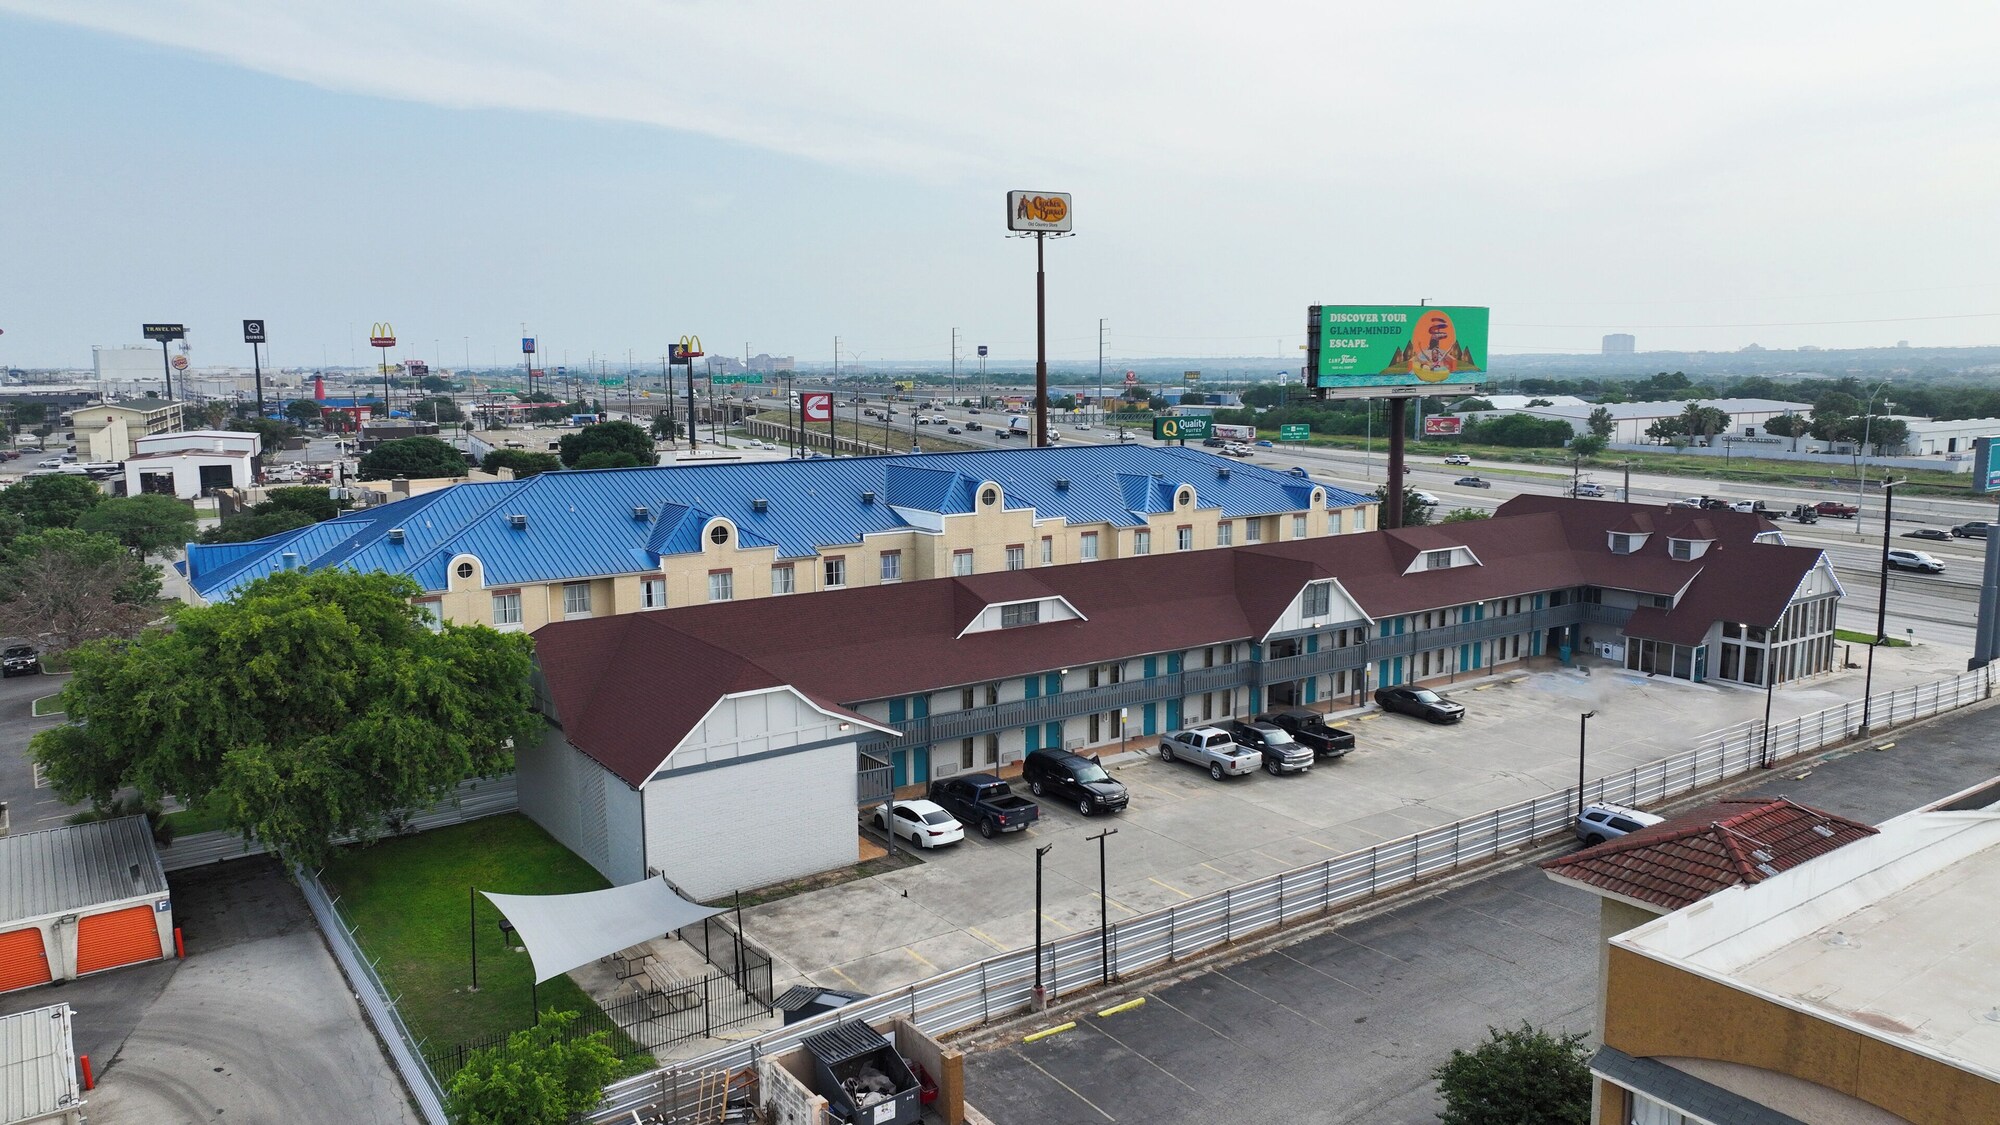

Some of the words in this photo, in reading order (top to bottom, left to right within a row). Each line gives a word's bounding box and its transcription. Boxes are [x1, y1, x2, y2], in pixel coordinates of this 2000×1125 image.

[1330, 314, 1378, 322] DISCOVER
[1380, 314, 1407, 322] YOUR
[1330, 326, 1402, 335] GLAMP-MINDED
[1329, 339, 1369, 348] ESCAPE.
[1179, 419, 1206, 430] Quality
[160, 901, 167, 910] F
